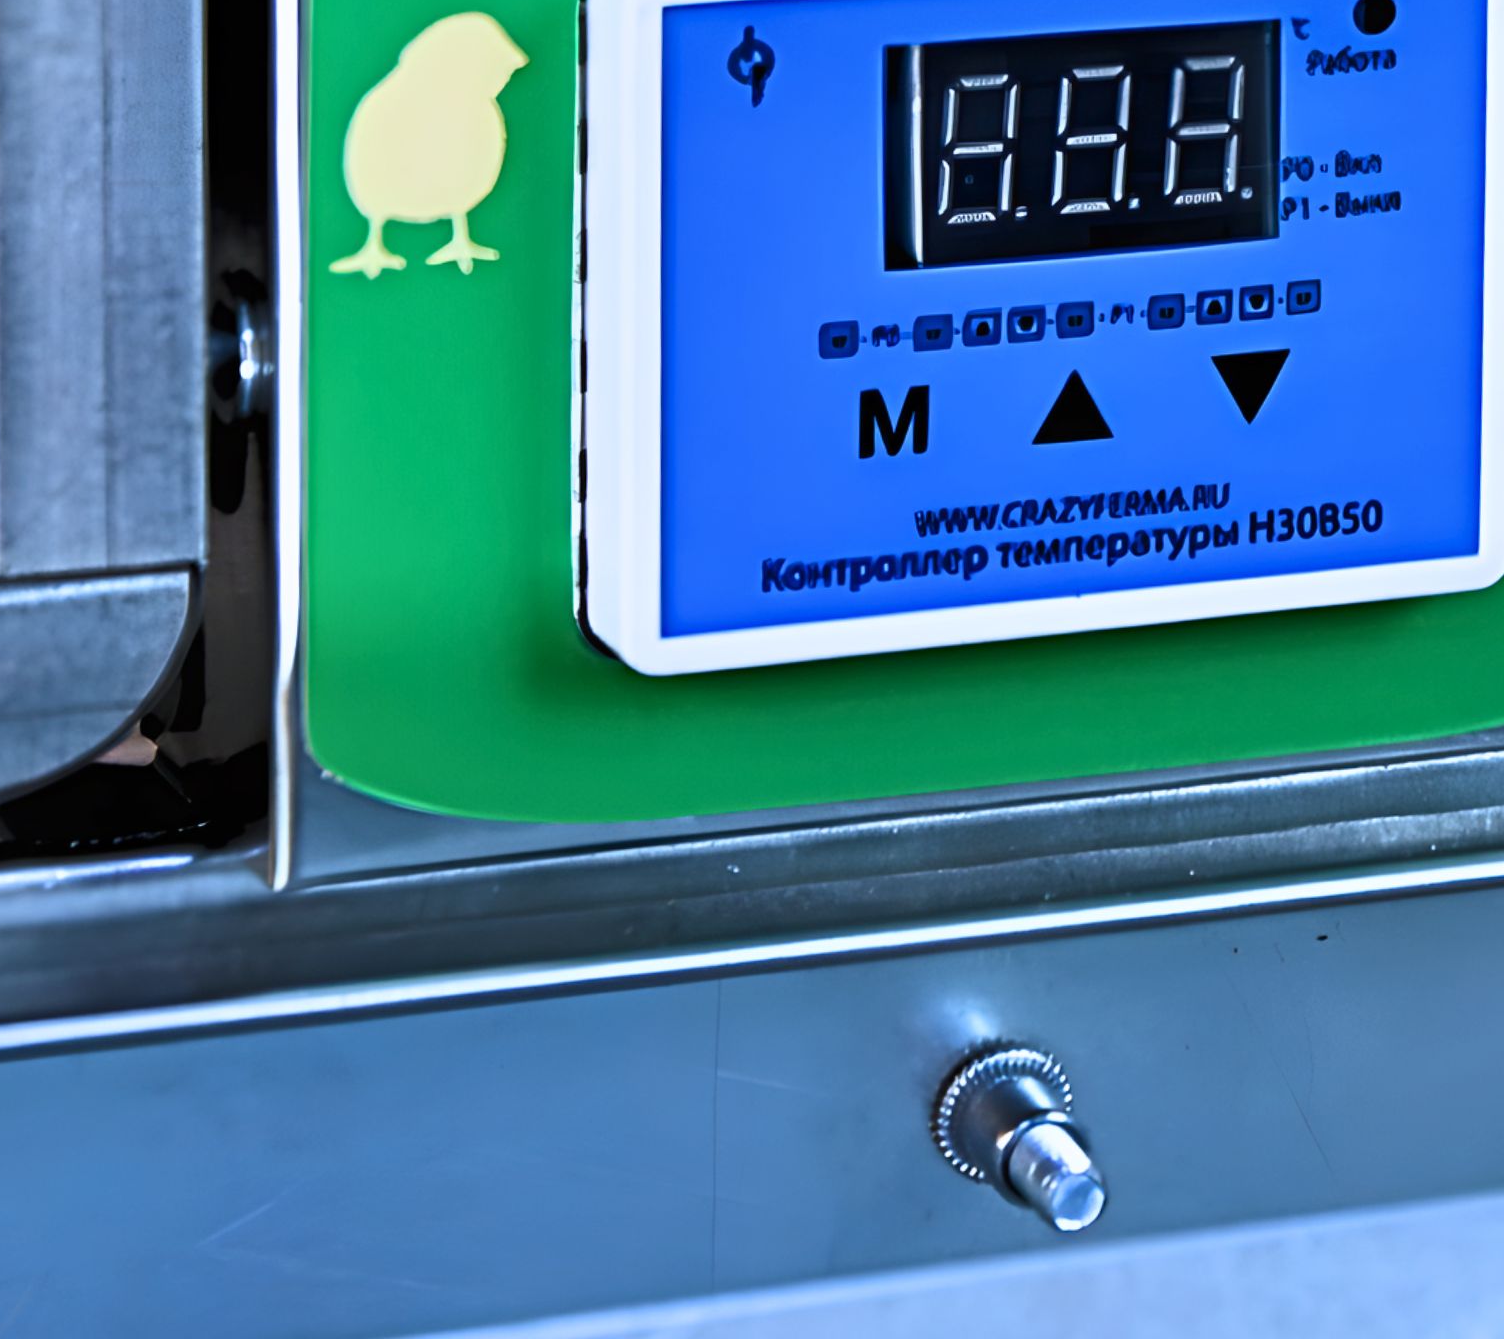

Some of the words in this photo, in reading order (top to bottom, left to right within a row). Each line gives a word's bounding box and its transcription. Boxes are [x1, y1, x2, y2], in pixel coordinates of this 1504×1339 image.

[858, 385, 930, 459] M
[761, 541, 989, 597] Контроллер
[1000, 519, 1239, 566] температуры
